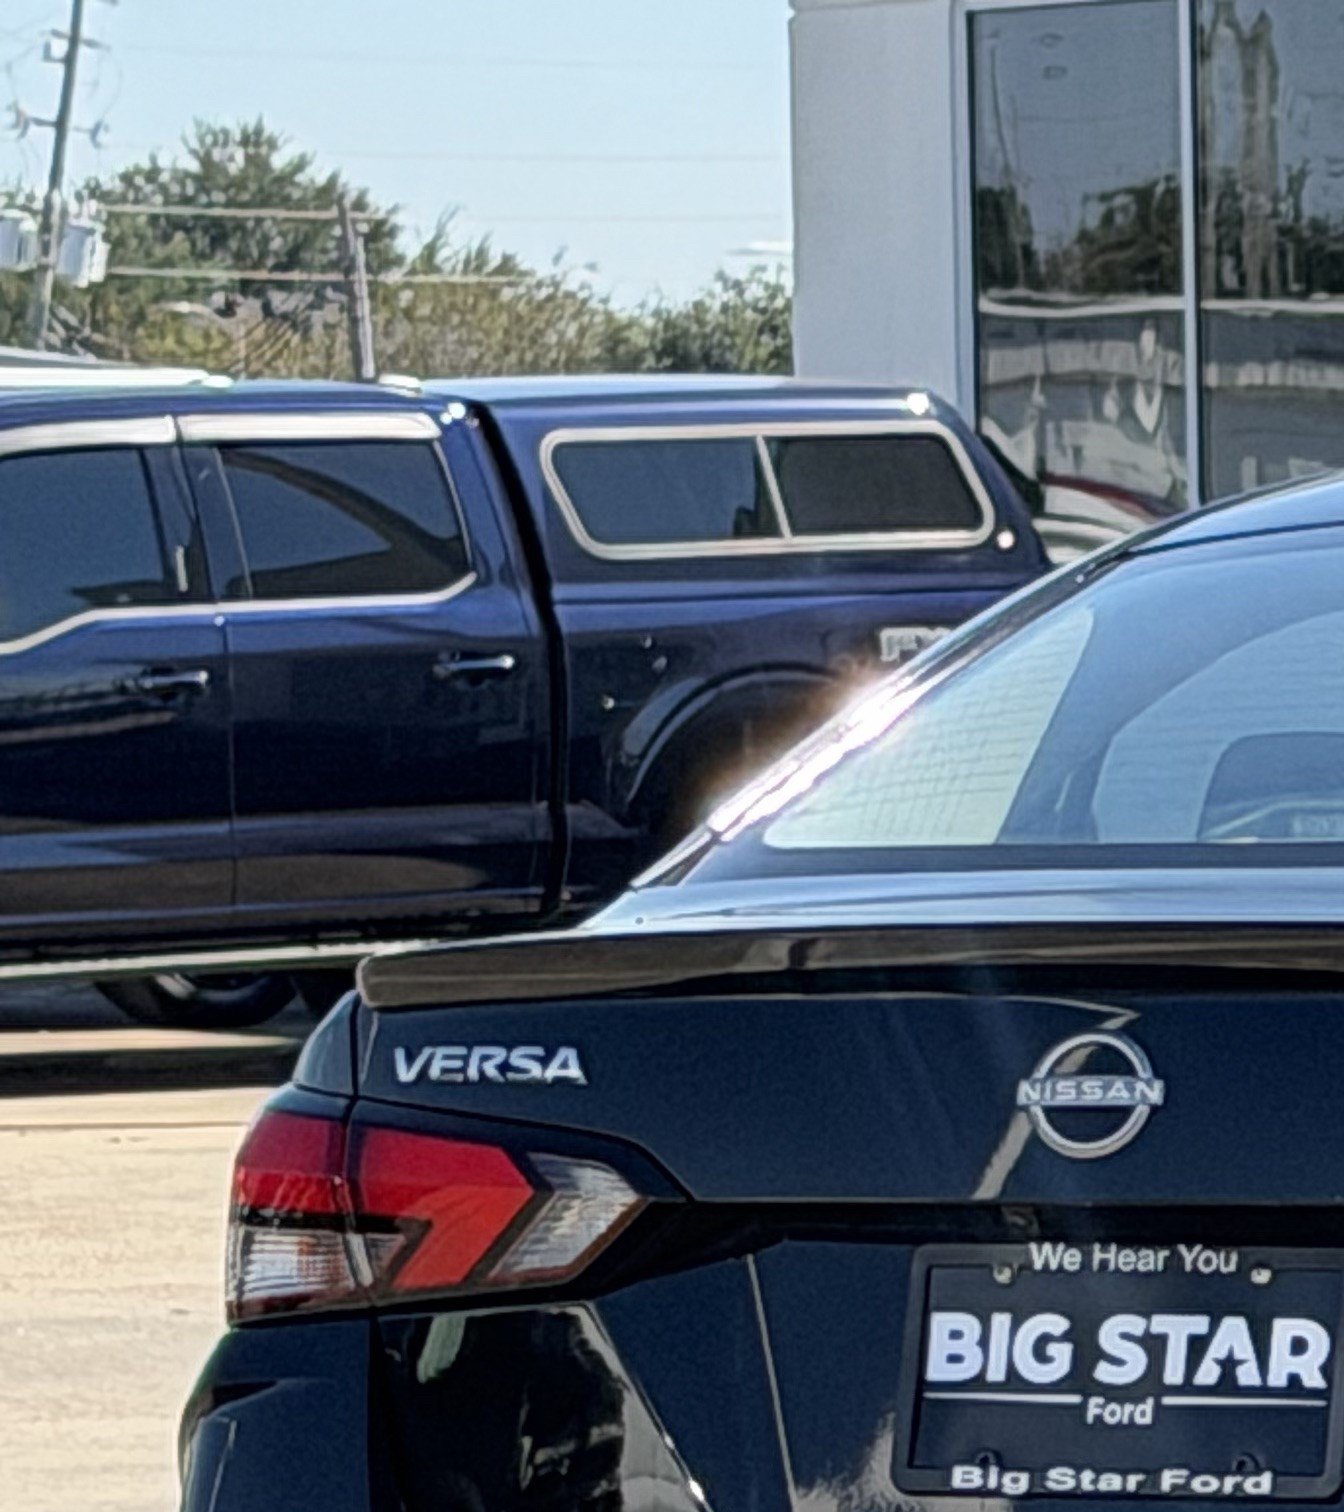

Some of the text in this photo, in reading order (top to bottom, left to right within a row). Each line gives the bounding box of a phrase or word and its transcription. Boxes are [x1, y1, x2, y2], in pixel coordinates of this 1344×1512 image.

[394, 1045, 588, 1084] VERSA
[1017, 1078, 1165, 1106] NISSAN
[1027, 1242, 1239, 1274] We Hear You
[925, 1311, 1332, 1389] BIG STAR
[1086, 1396, 1155, 1425] Ford
[951, 1464, 1273, 1495] Big Star Ford
